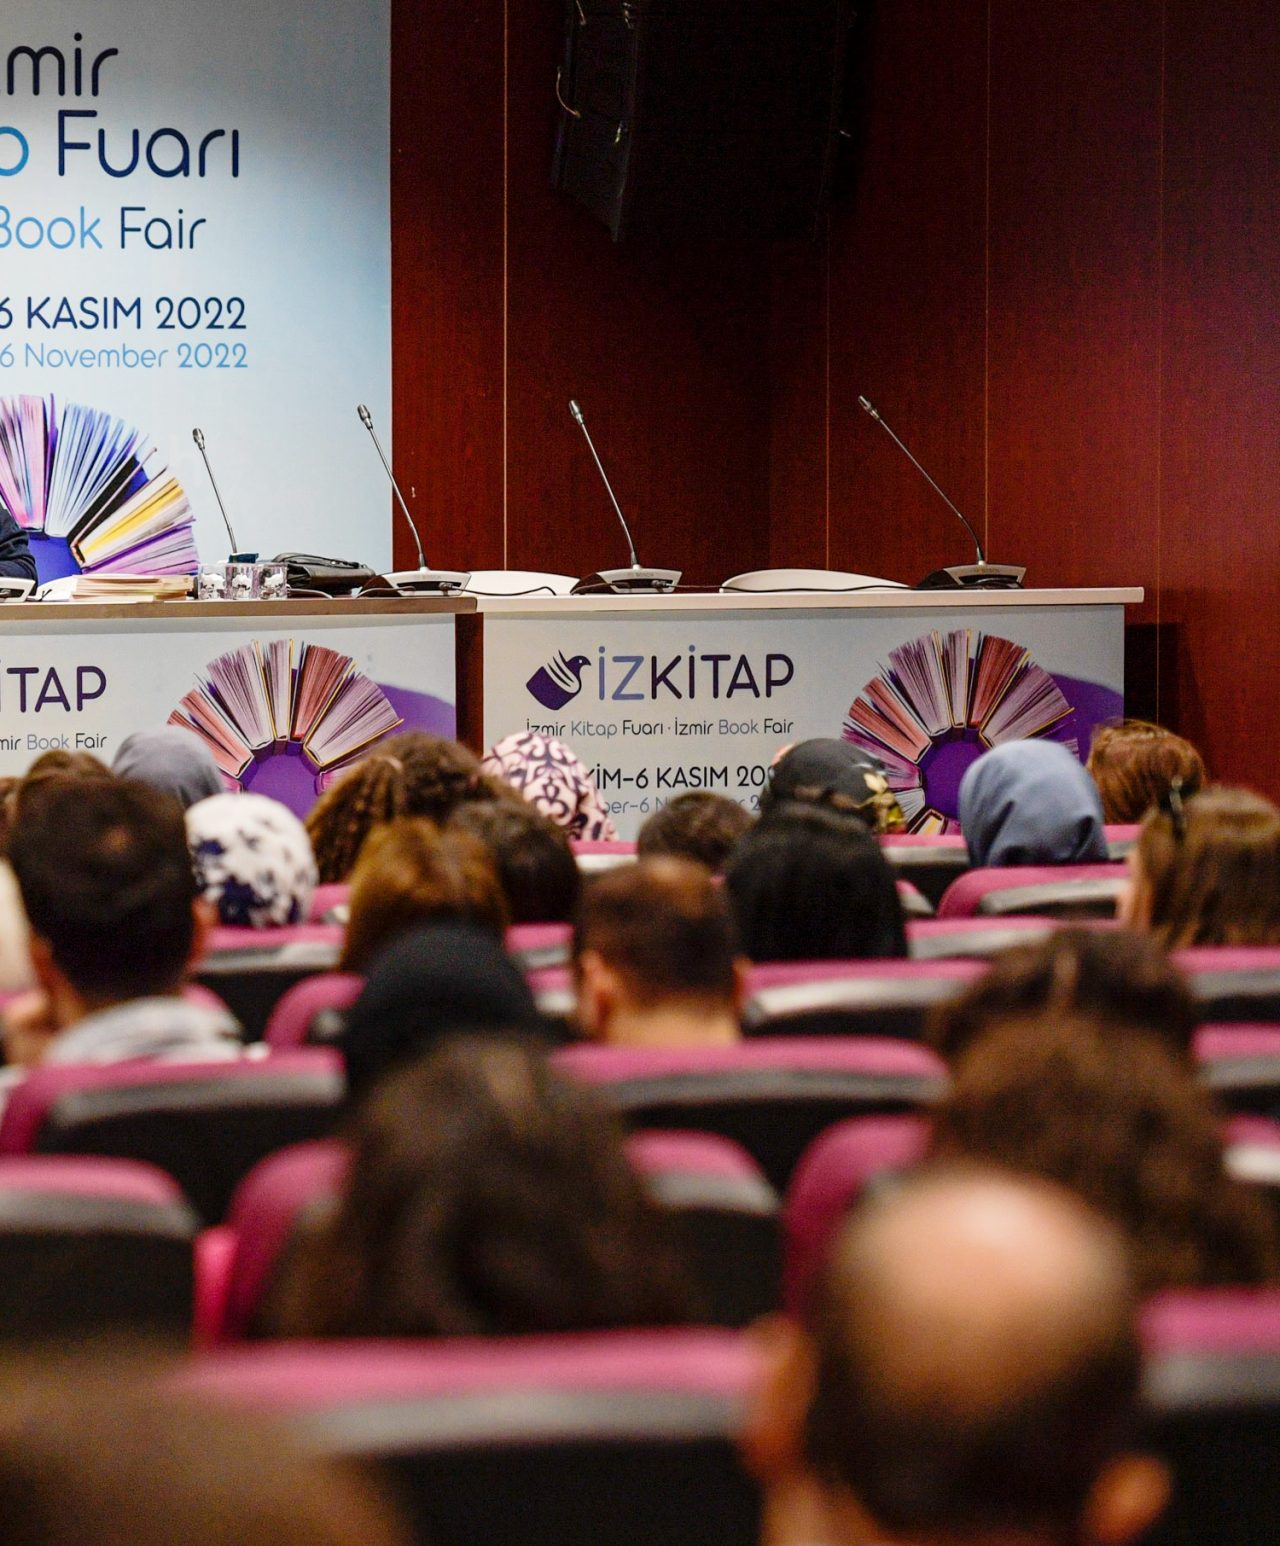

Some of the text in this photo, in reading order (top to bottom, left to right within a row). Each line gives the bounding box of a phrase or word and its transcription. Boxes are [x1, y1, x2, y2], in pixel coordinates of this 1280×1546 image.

[58, 110, 239, 178] Fuarı
[121, 207, 206, 249] Fair
[28, 297, 141, 329] KASIM
[156, 297, 246, 329] 2022
[25, 343, 168, 368] November
[177, 343, 248, 368] 2022
[599, 645, 794, 700] İZKİTAP
[27, 734, 70, 750] Book
[76, 733, 107, 748] Fair
[571, 721, 617, 739] Kitap
[623, 720, 663, 735] Fuarı
[675, 717, 713, 735] İzmir
[719, 719, 759, 735] Book
[764, 718, 794, 733] Fair
[587, 763, 649, 790] İM-6
[655, 764, 729, 791] KASIM
